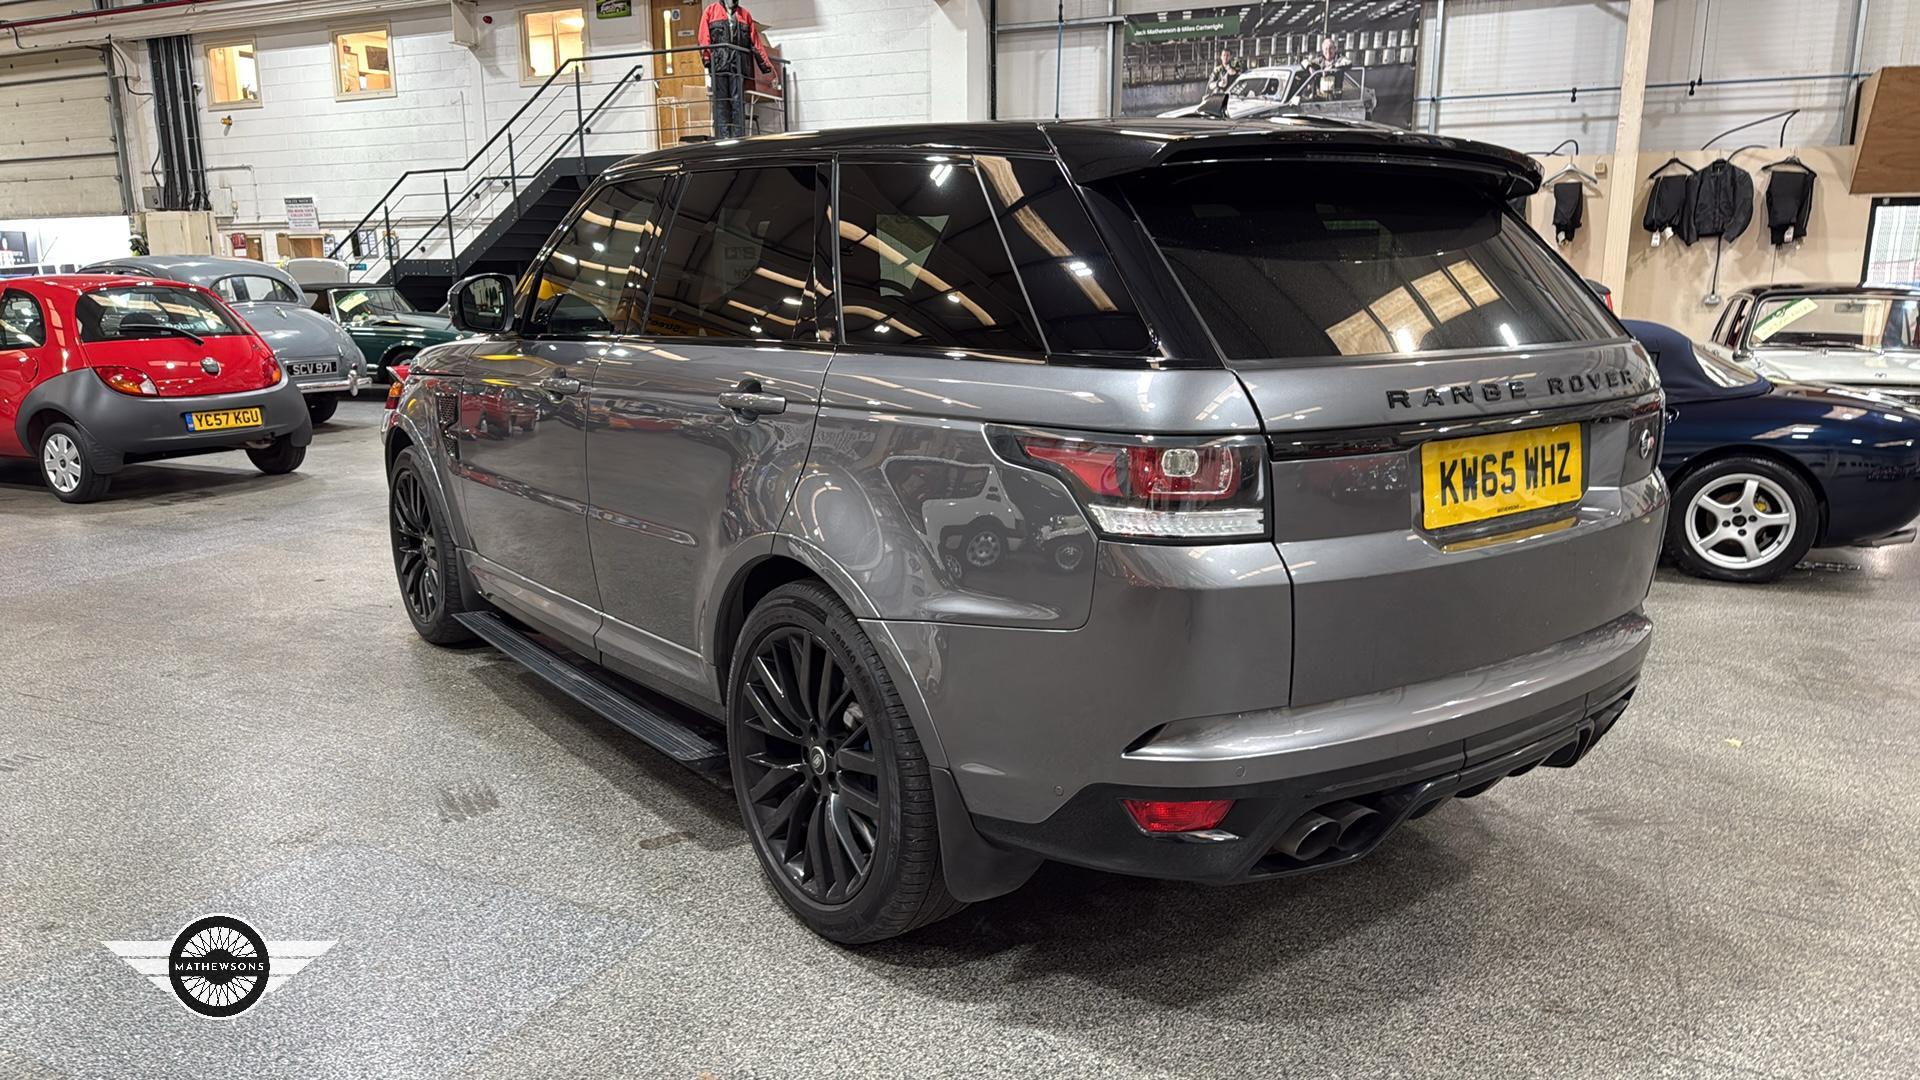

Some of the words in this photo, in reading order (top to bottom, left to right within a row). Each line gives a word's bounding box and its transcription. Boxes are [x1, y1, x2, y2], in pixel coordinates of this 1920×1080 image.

[1196, 23, 1224, 32] Cartwright
[292, 363, 314, 376] SCV
[315, 362, 333, 374] 971
[1386, 381, 1527, 409] RANGE
[1547, 370, 1632, 396] ROVER
[195, 412, 230, 427] YC57
[233, 409, 260, 425] KGU
[1440, 450, 1517, 506] KW65
[1524, 442, 1571, 490] WHZ
